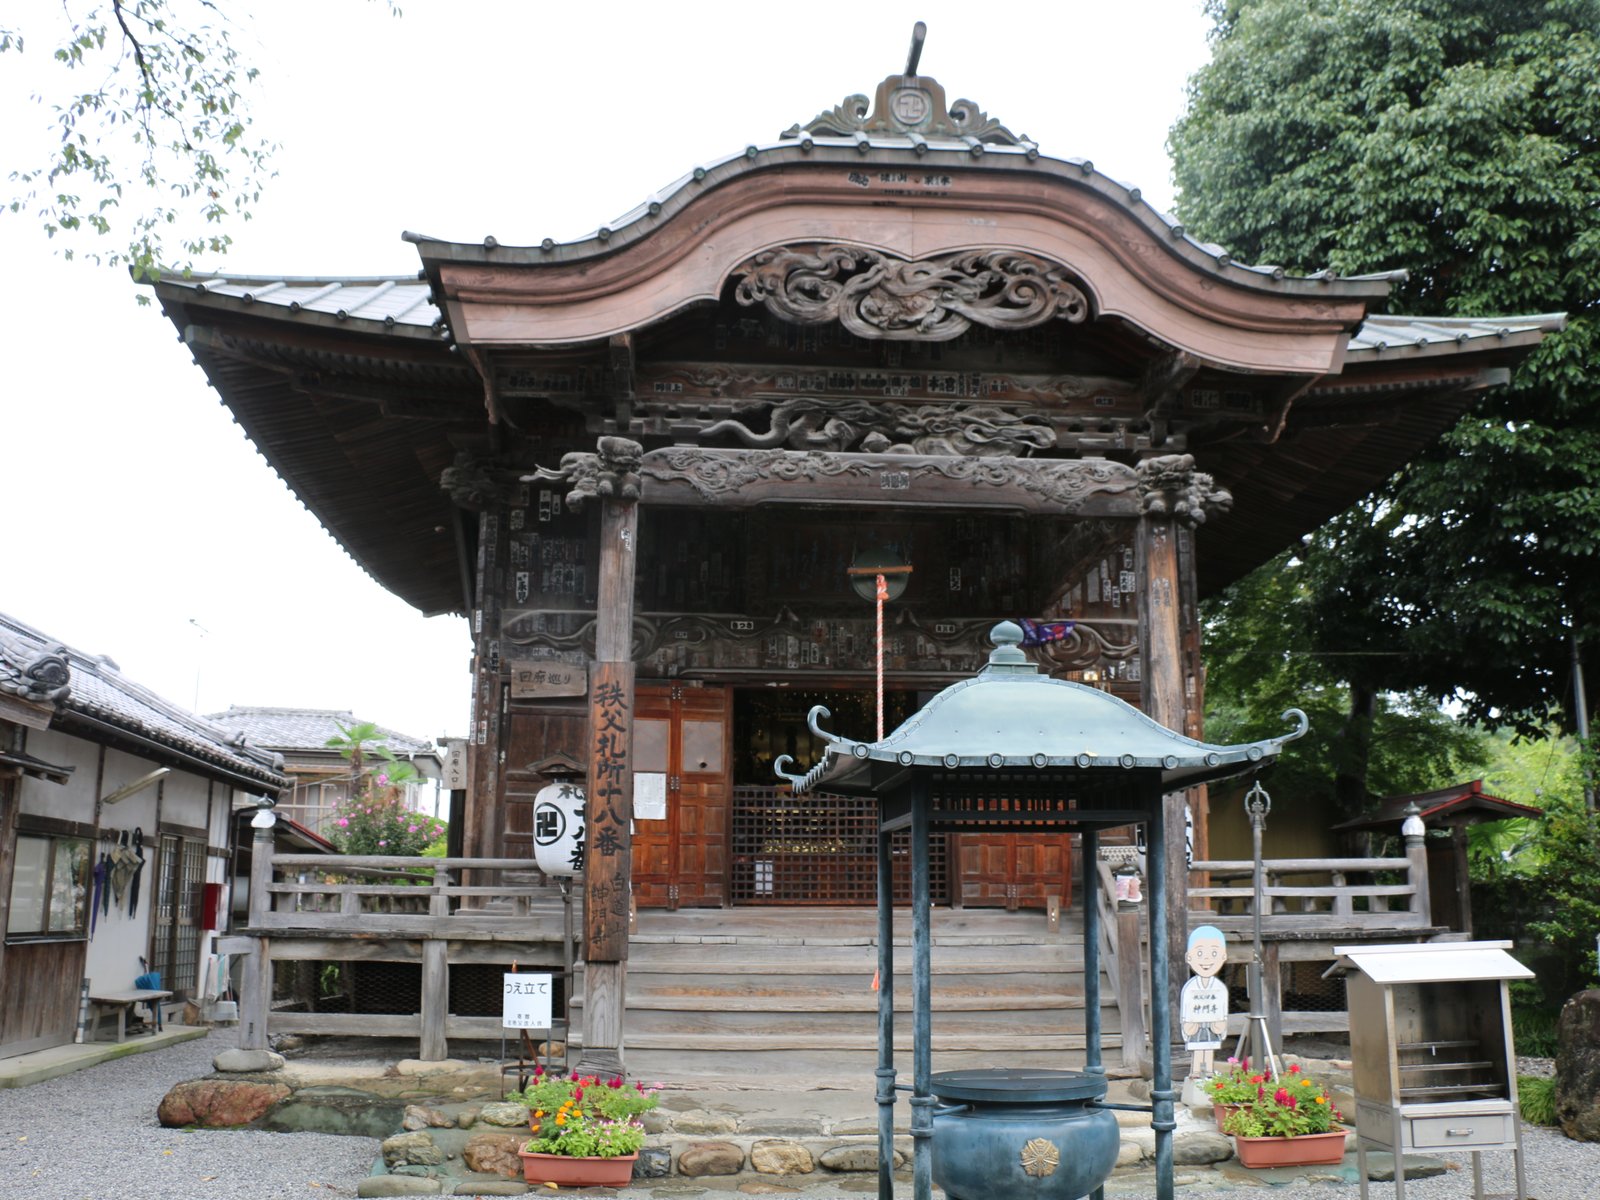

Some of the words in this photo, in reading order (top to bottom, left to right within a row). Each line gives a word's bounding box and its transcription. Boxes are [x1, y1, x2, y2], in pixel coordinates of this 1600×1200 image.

[519, 669, 572, 685] 回廊巡り
[593, 680, 628, 857] 秩父札所十八番
[504, 981, 548, 995] つえ立て
